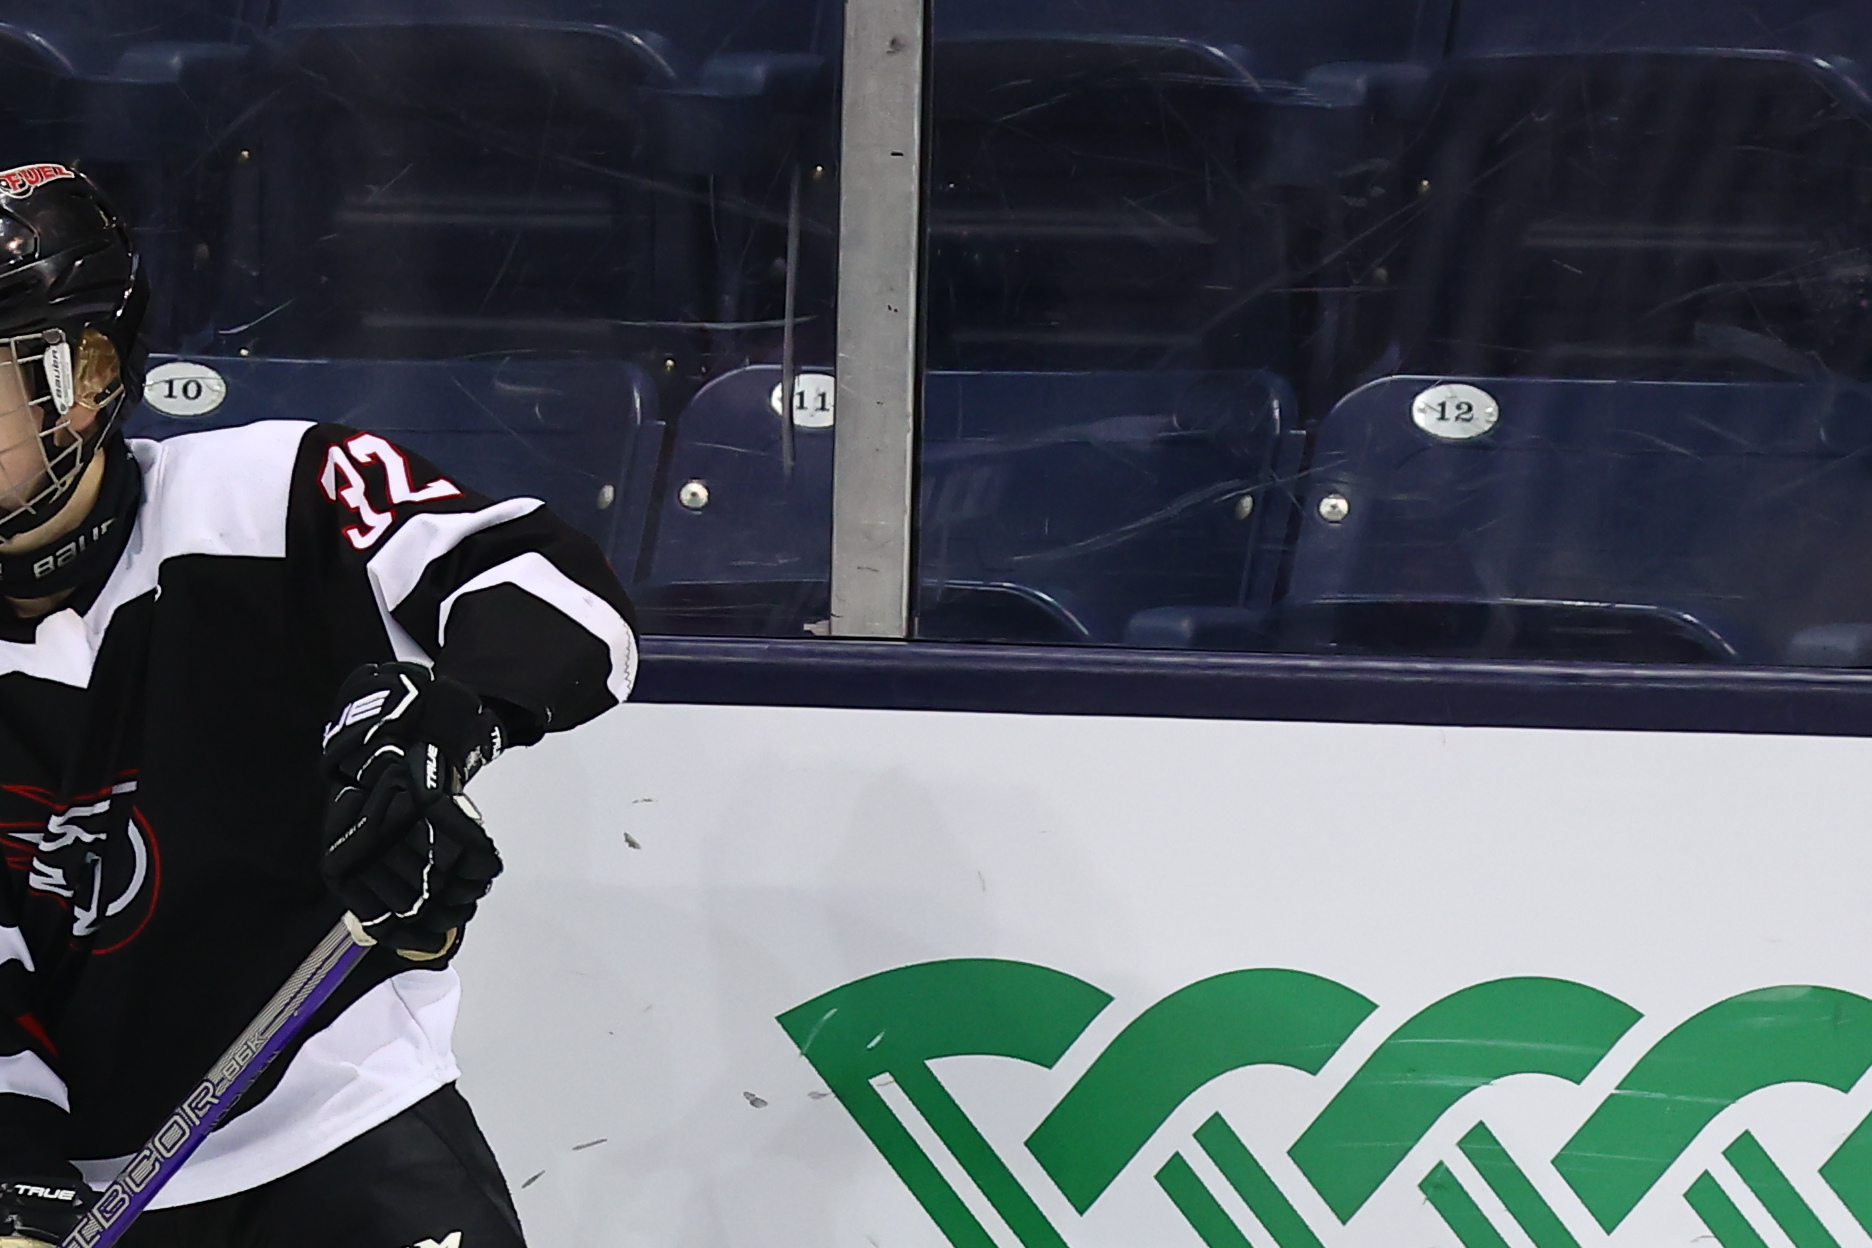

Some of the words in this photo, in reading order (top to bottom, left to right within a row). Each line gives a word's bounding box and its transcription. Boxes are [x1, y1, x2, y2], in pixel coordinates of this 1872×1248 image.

[1, 164, 73, 192] FUEL
[162, 378, 203, 401] 10
[795, 389, 831, 413] 11
[1436, 400, 1475, 423] 12
[318, 431, 465, 551] 32
[425, 742, 439, 789] TRUE
[13, 1184, 76, 1201] TRUE
